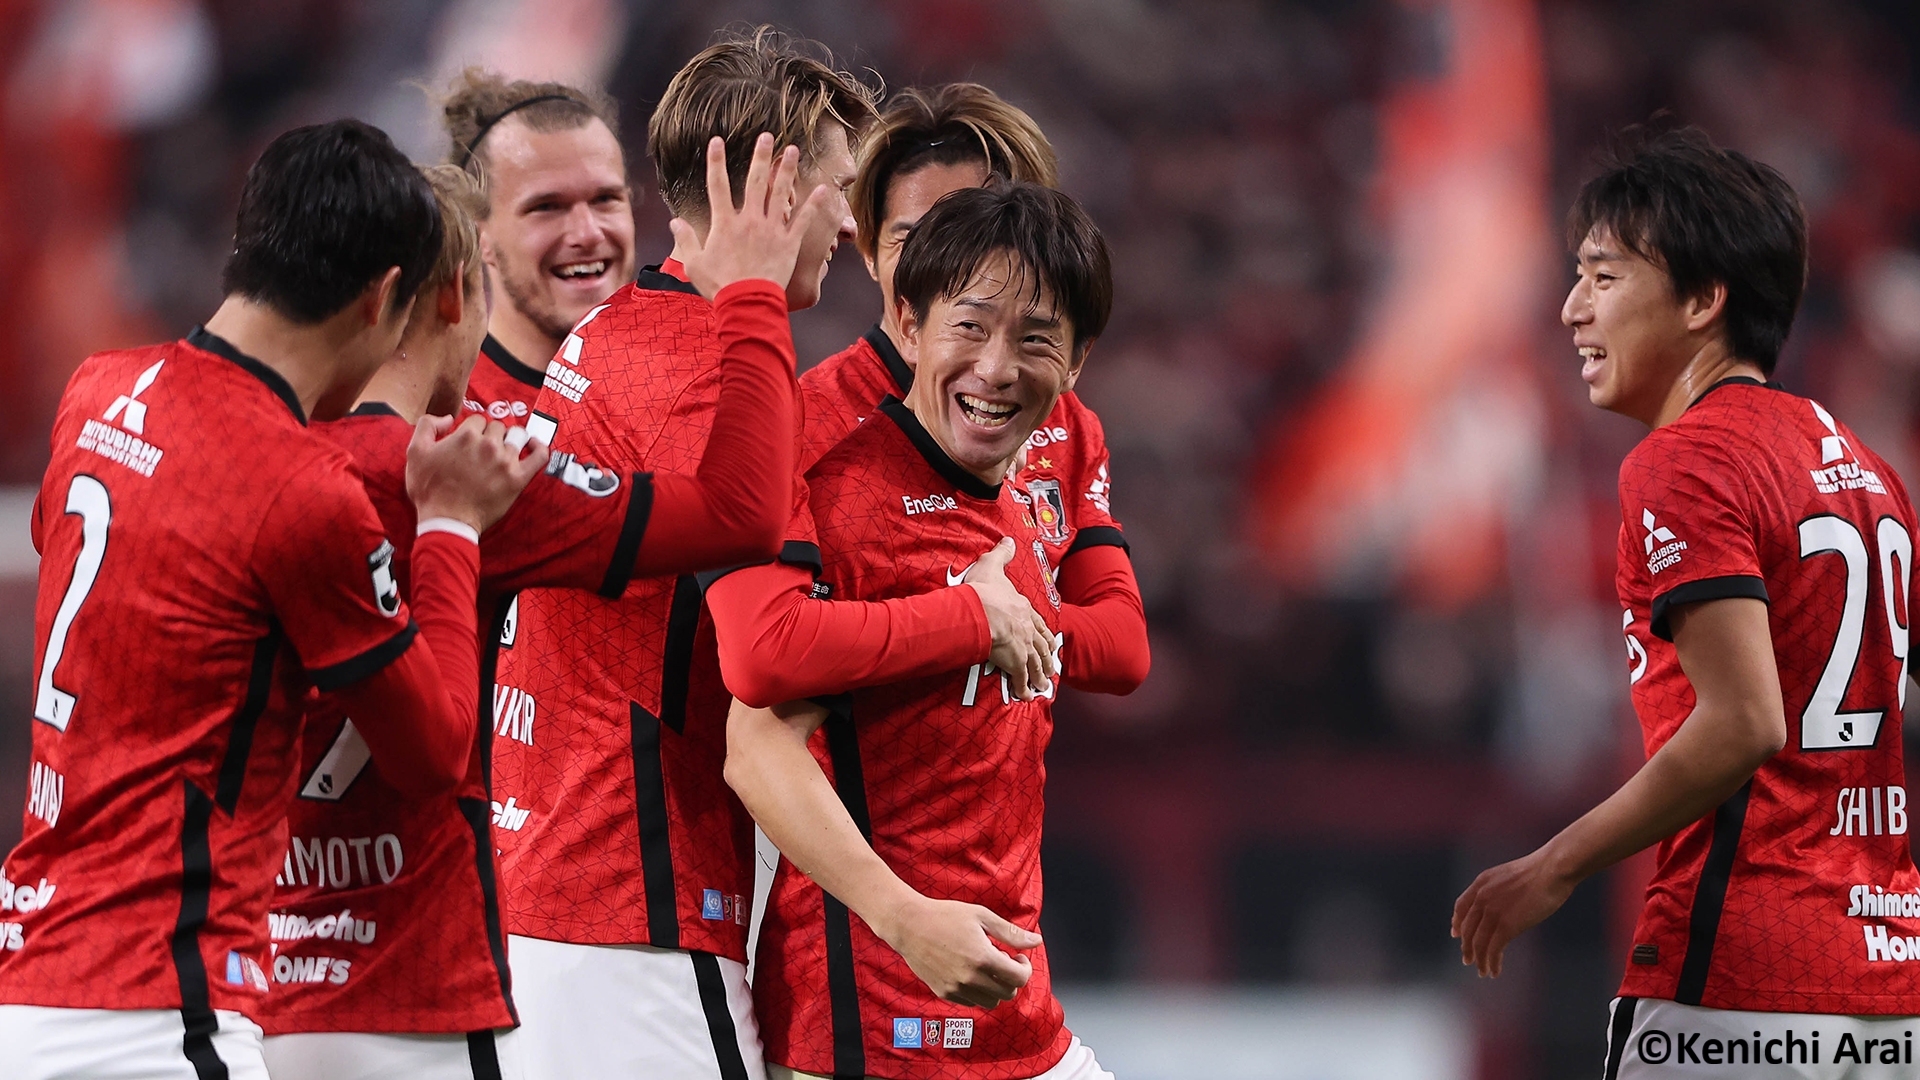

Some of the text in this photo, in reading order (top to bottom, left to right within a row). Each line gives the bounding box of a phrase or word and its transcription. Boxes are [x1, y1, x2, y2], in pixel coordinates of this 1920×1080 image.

[81, 418, 164, 467] MITSUBISHI
[34, 473, 112, 733] 2
[811, 581, 830, 595] 生命
[1797, 513, 1913, 750] 29
[1829, 785, 1909, 837] SHIB
[945, 1020, 973, 1028] SPORTS
[951, 1029, 966, 1037] FOR
[946, 1037, 971, 1046] PEACE!
